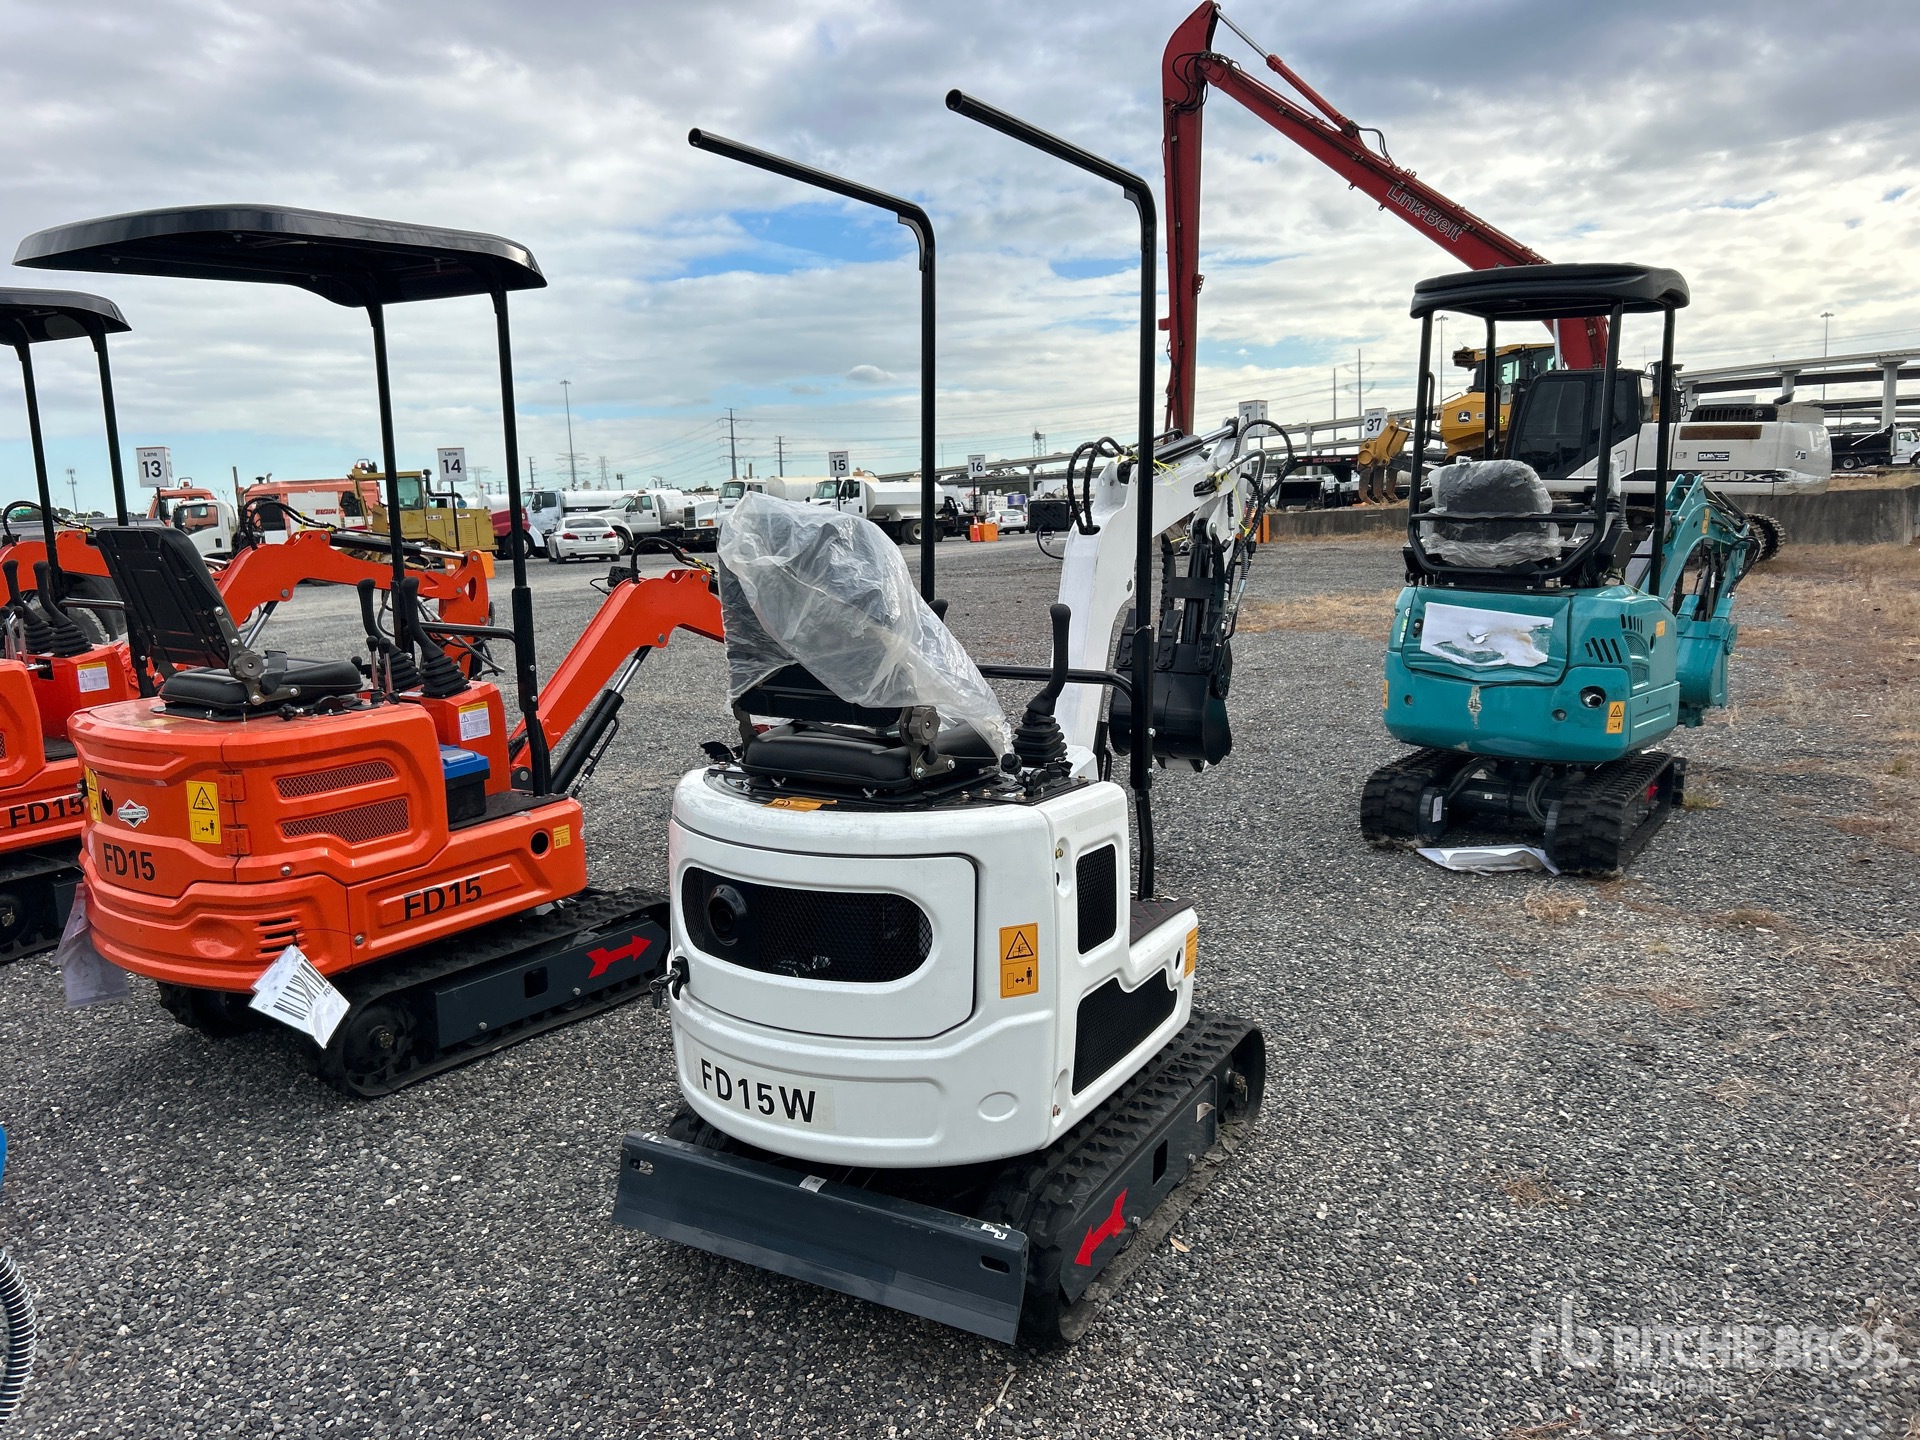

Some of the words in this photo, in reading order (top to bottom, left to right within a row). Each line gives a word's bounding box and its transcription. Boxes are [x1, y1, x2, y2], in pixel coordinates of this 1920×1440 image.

[1387, 181, 1463, 243] Link-Belt
[1366, 417, 1382, 432] 37
[141, 460, 162, 478] 13
[442, 458, 462, 474] 14
[832, 459, 846, 471] 15
[970, 461, 983, 472] 16
[8, 795, 85, 829] FD15
[103, 842, 156, 881] FD15
[403, 875, 482, 921] FD15
[700, 1057, 816, 1123] FD15W
